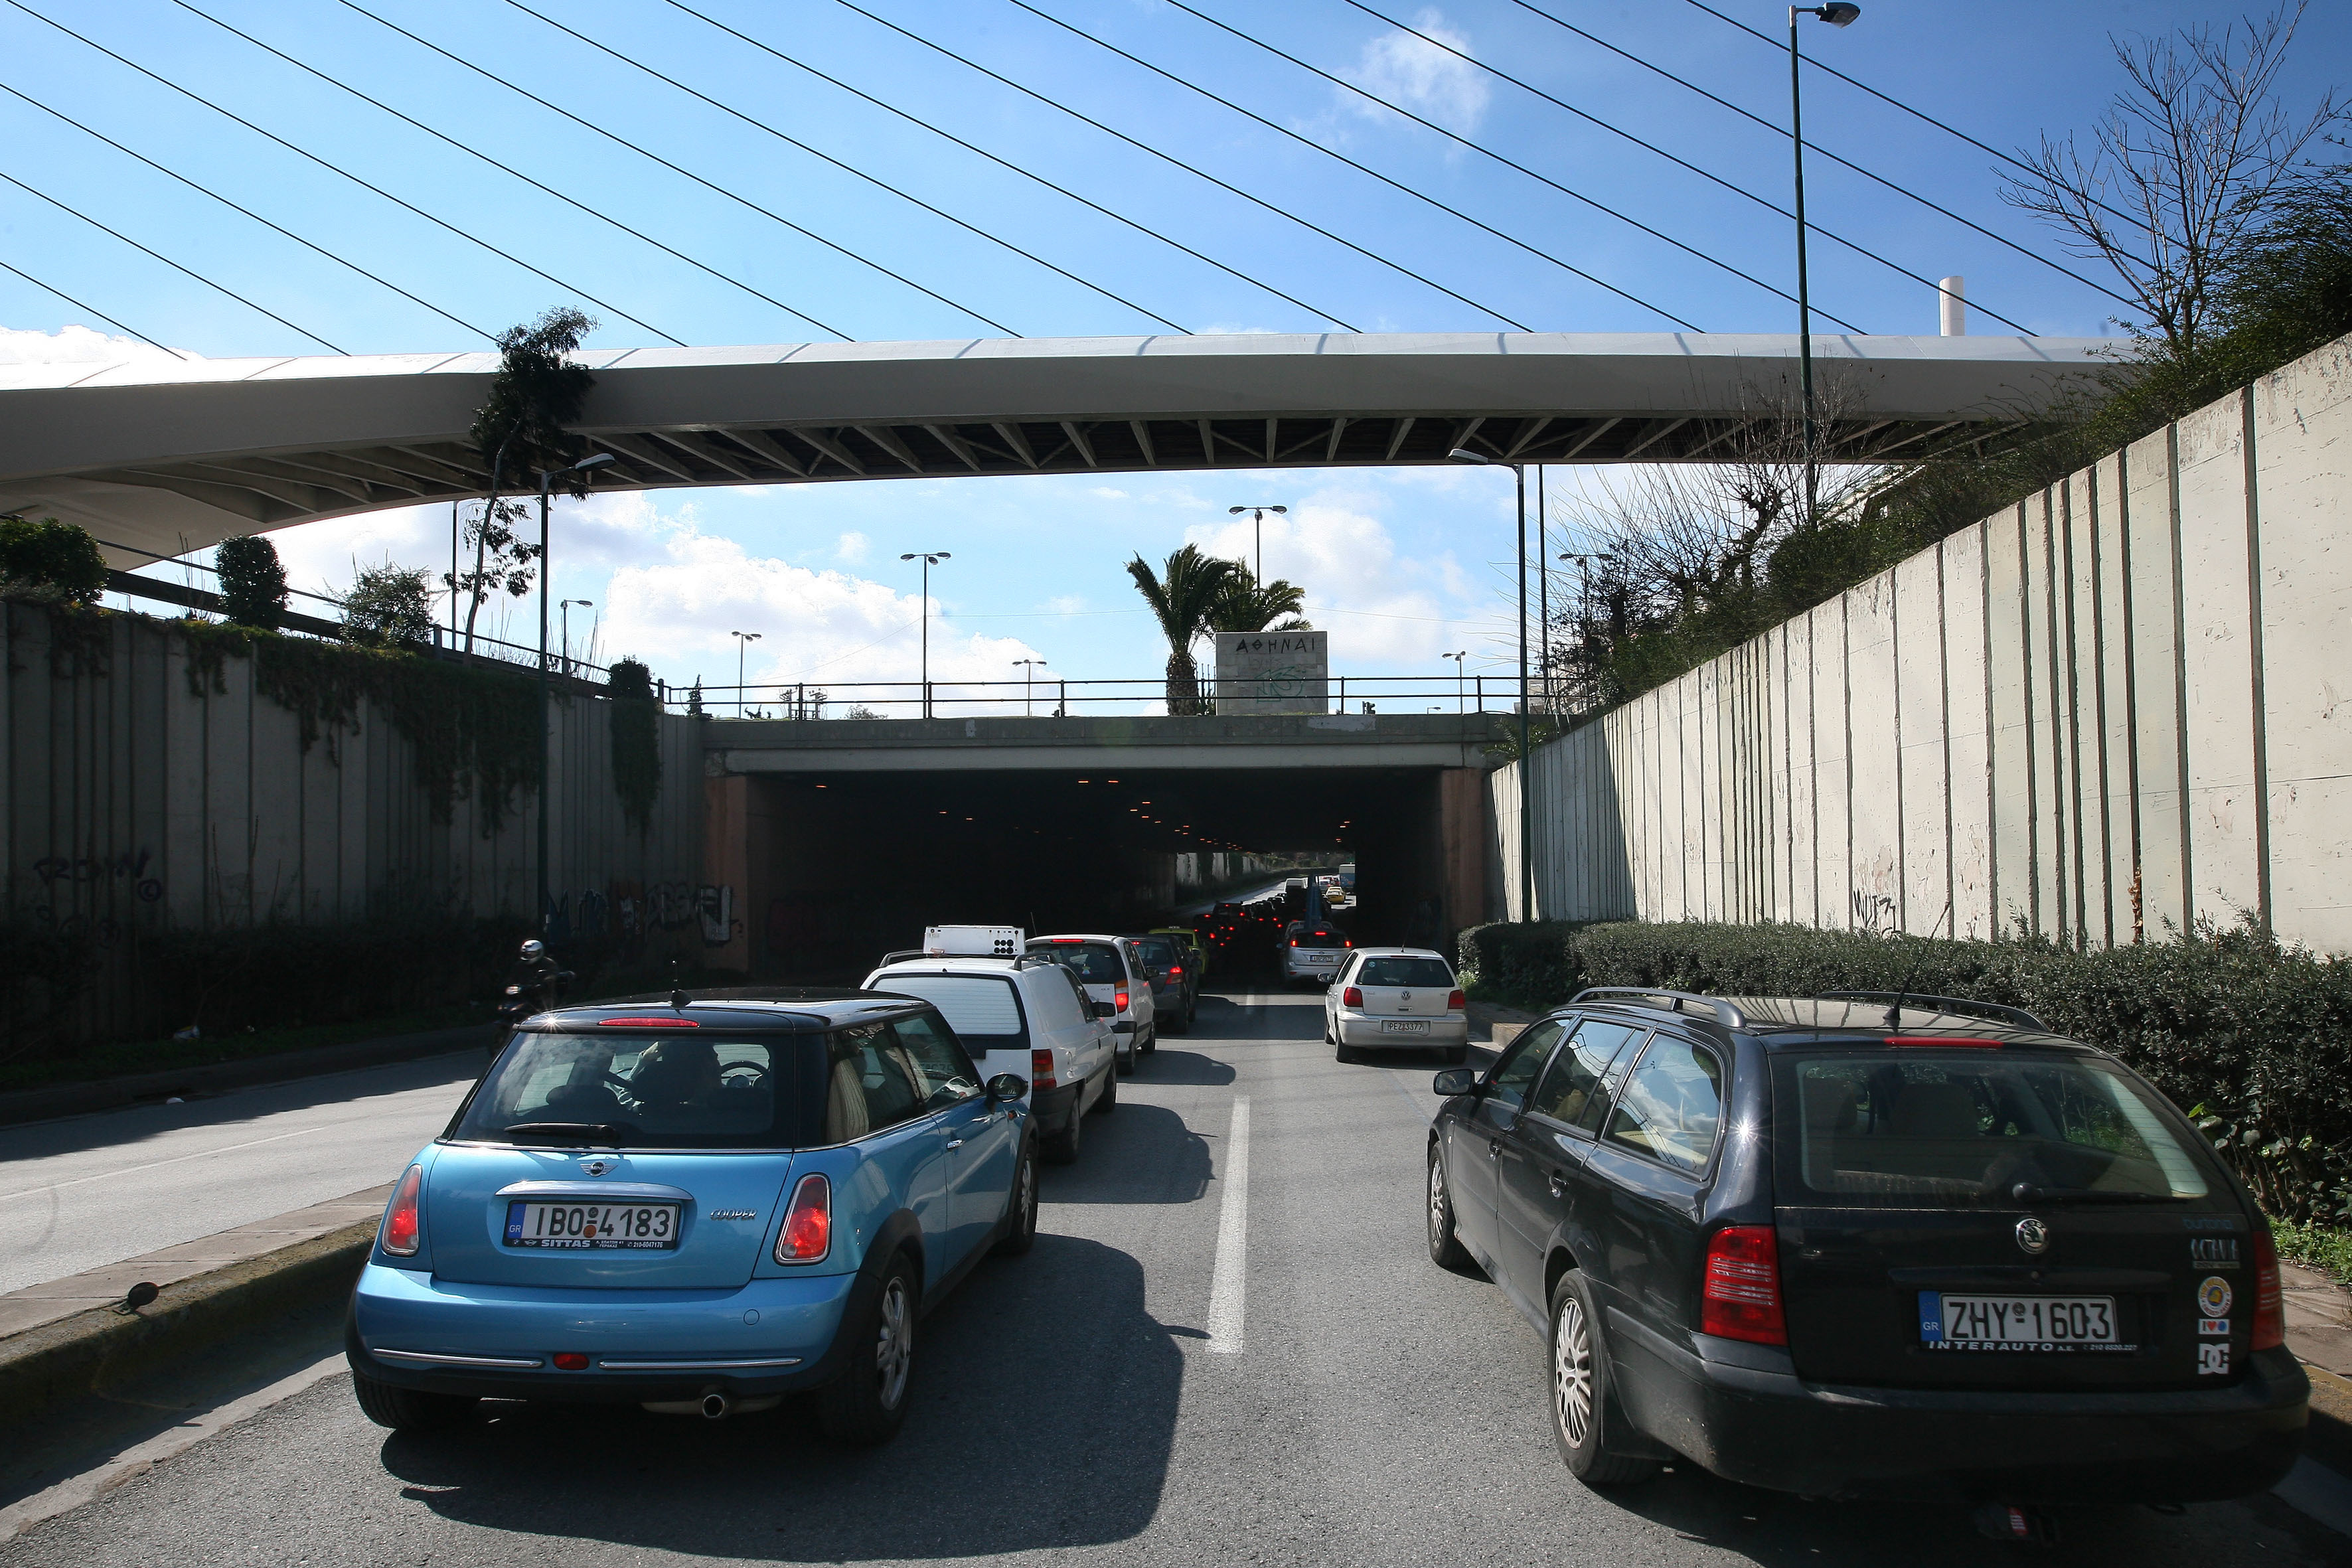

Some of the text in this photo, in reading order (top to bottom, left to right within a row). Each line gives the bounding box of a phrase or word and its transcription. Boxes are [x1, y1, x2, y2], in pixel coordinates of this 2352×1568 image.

[1236, 638, 1315, 654] ΑΘΗΝΑΙ
[709, 1208, 757, 1220] COOPER
[541, 1239, 591, 1248] SITTAS
[1922, 1322, 1939, 1331] GR
[1928, 1340, 2054, 1352] INTERAUTO
